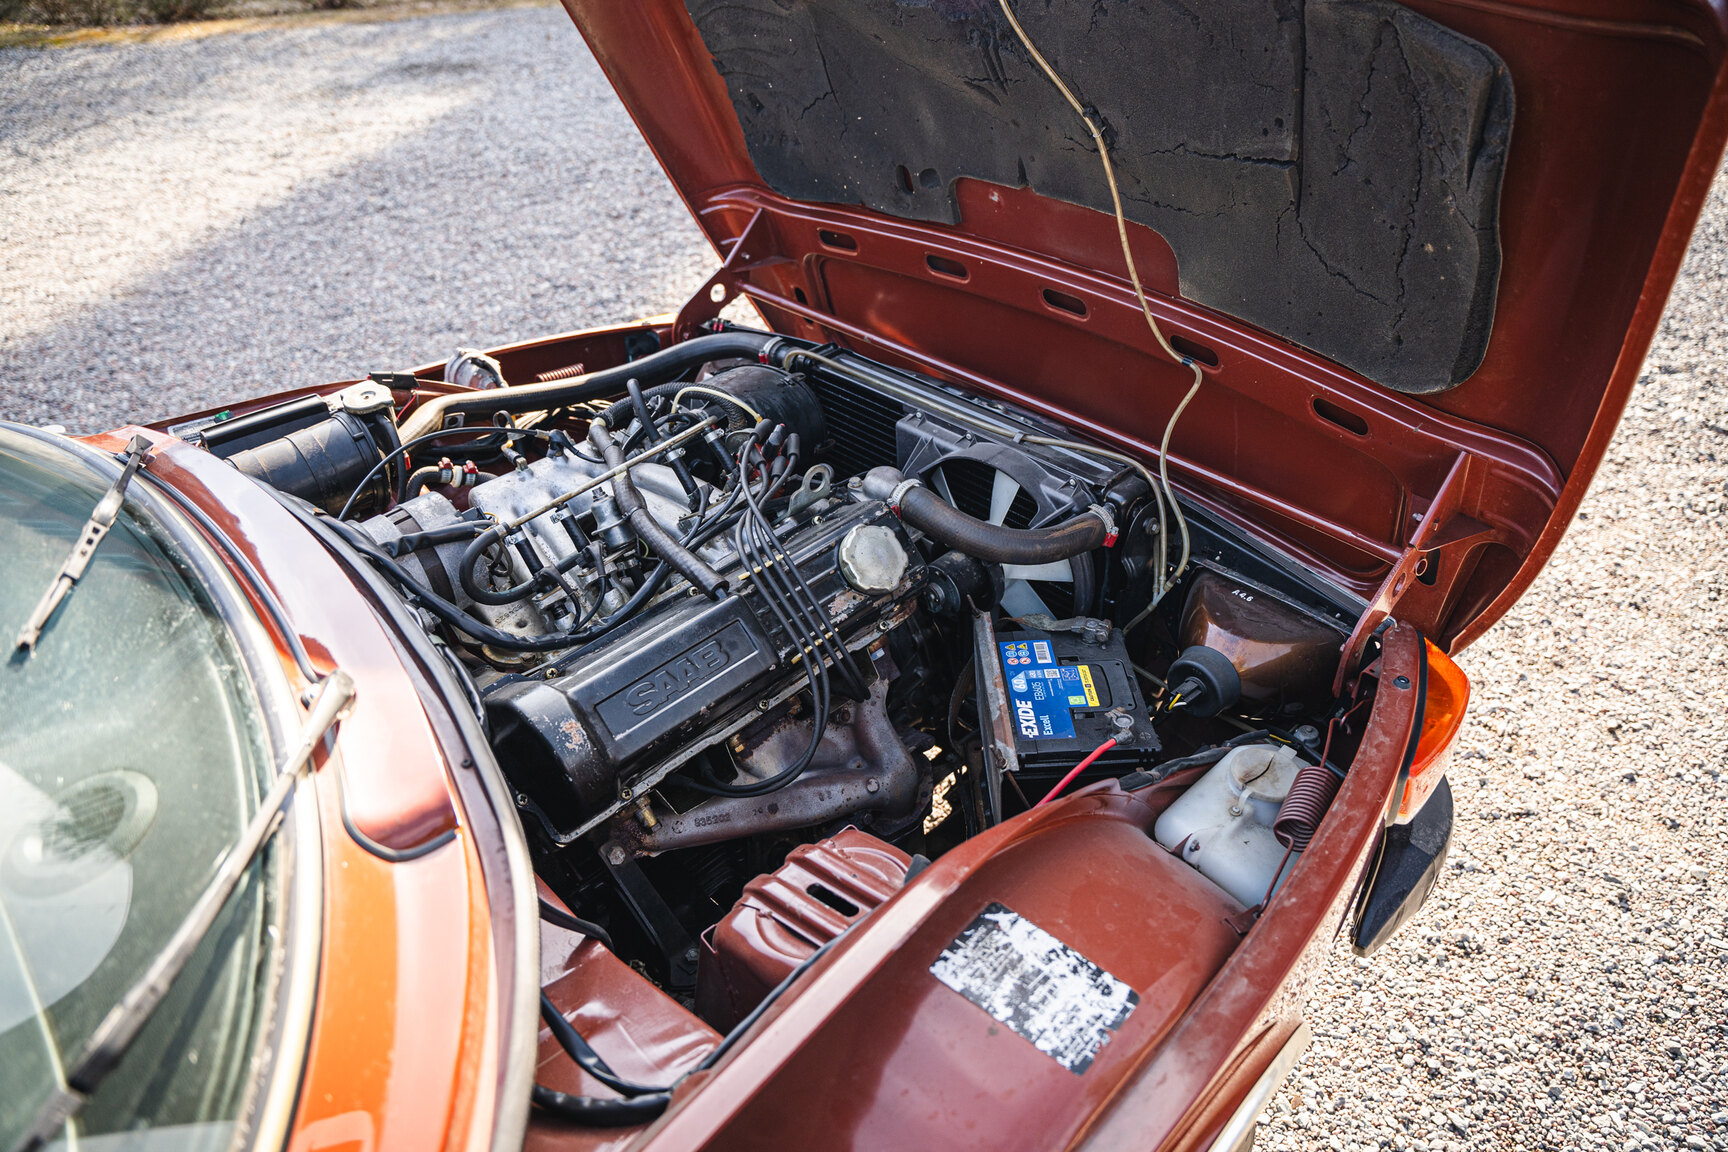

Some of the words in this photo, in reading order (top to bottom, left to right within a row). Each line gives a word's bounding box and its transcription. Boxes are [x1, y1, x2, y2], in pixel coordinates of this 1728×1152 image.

[626, 640, 730, 716] SAAB
[1013, 679, 1026, 688] 60
[1015, 699, 1039, 737] EXIDE
[1040, 714, 1053, 736] Excell
